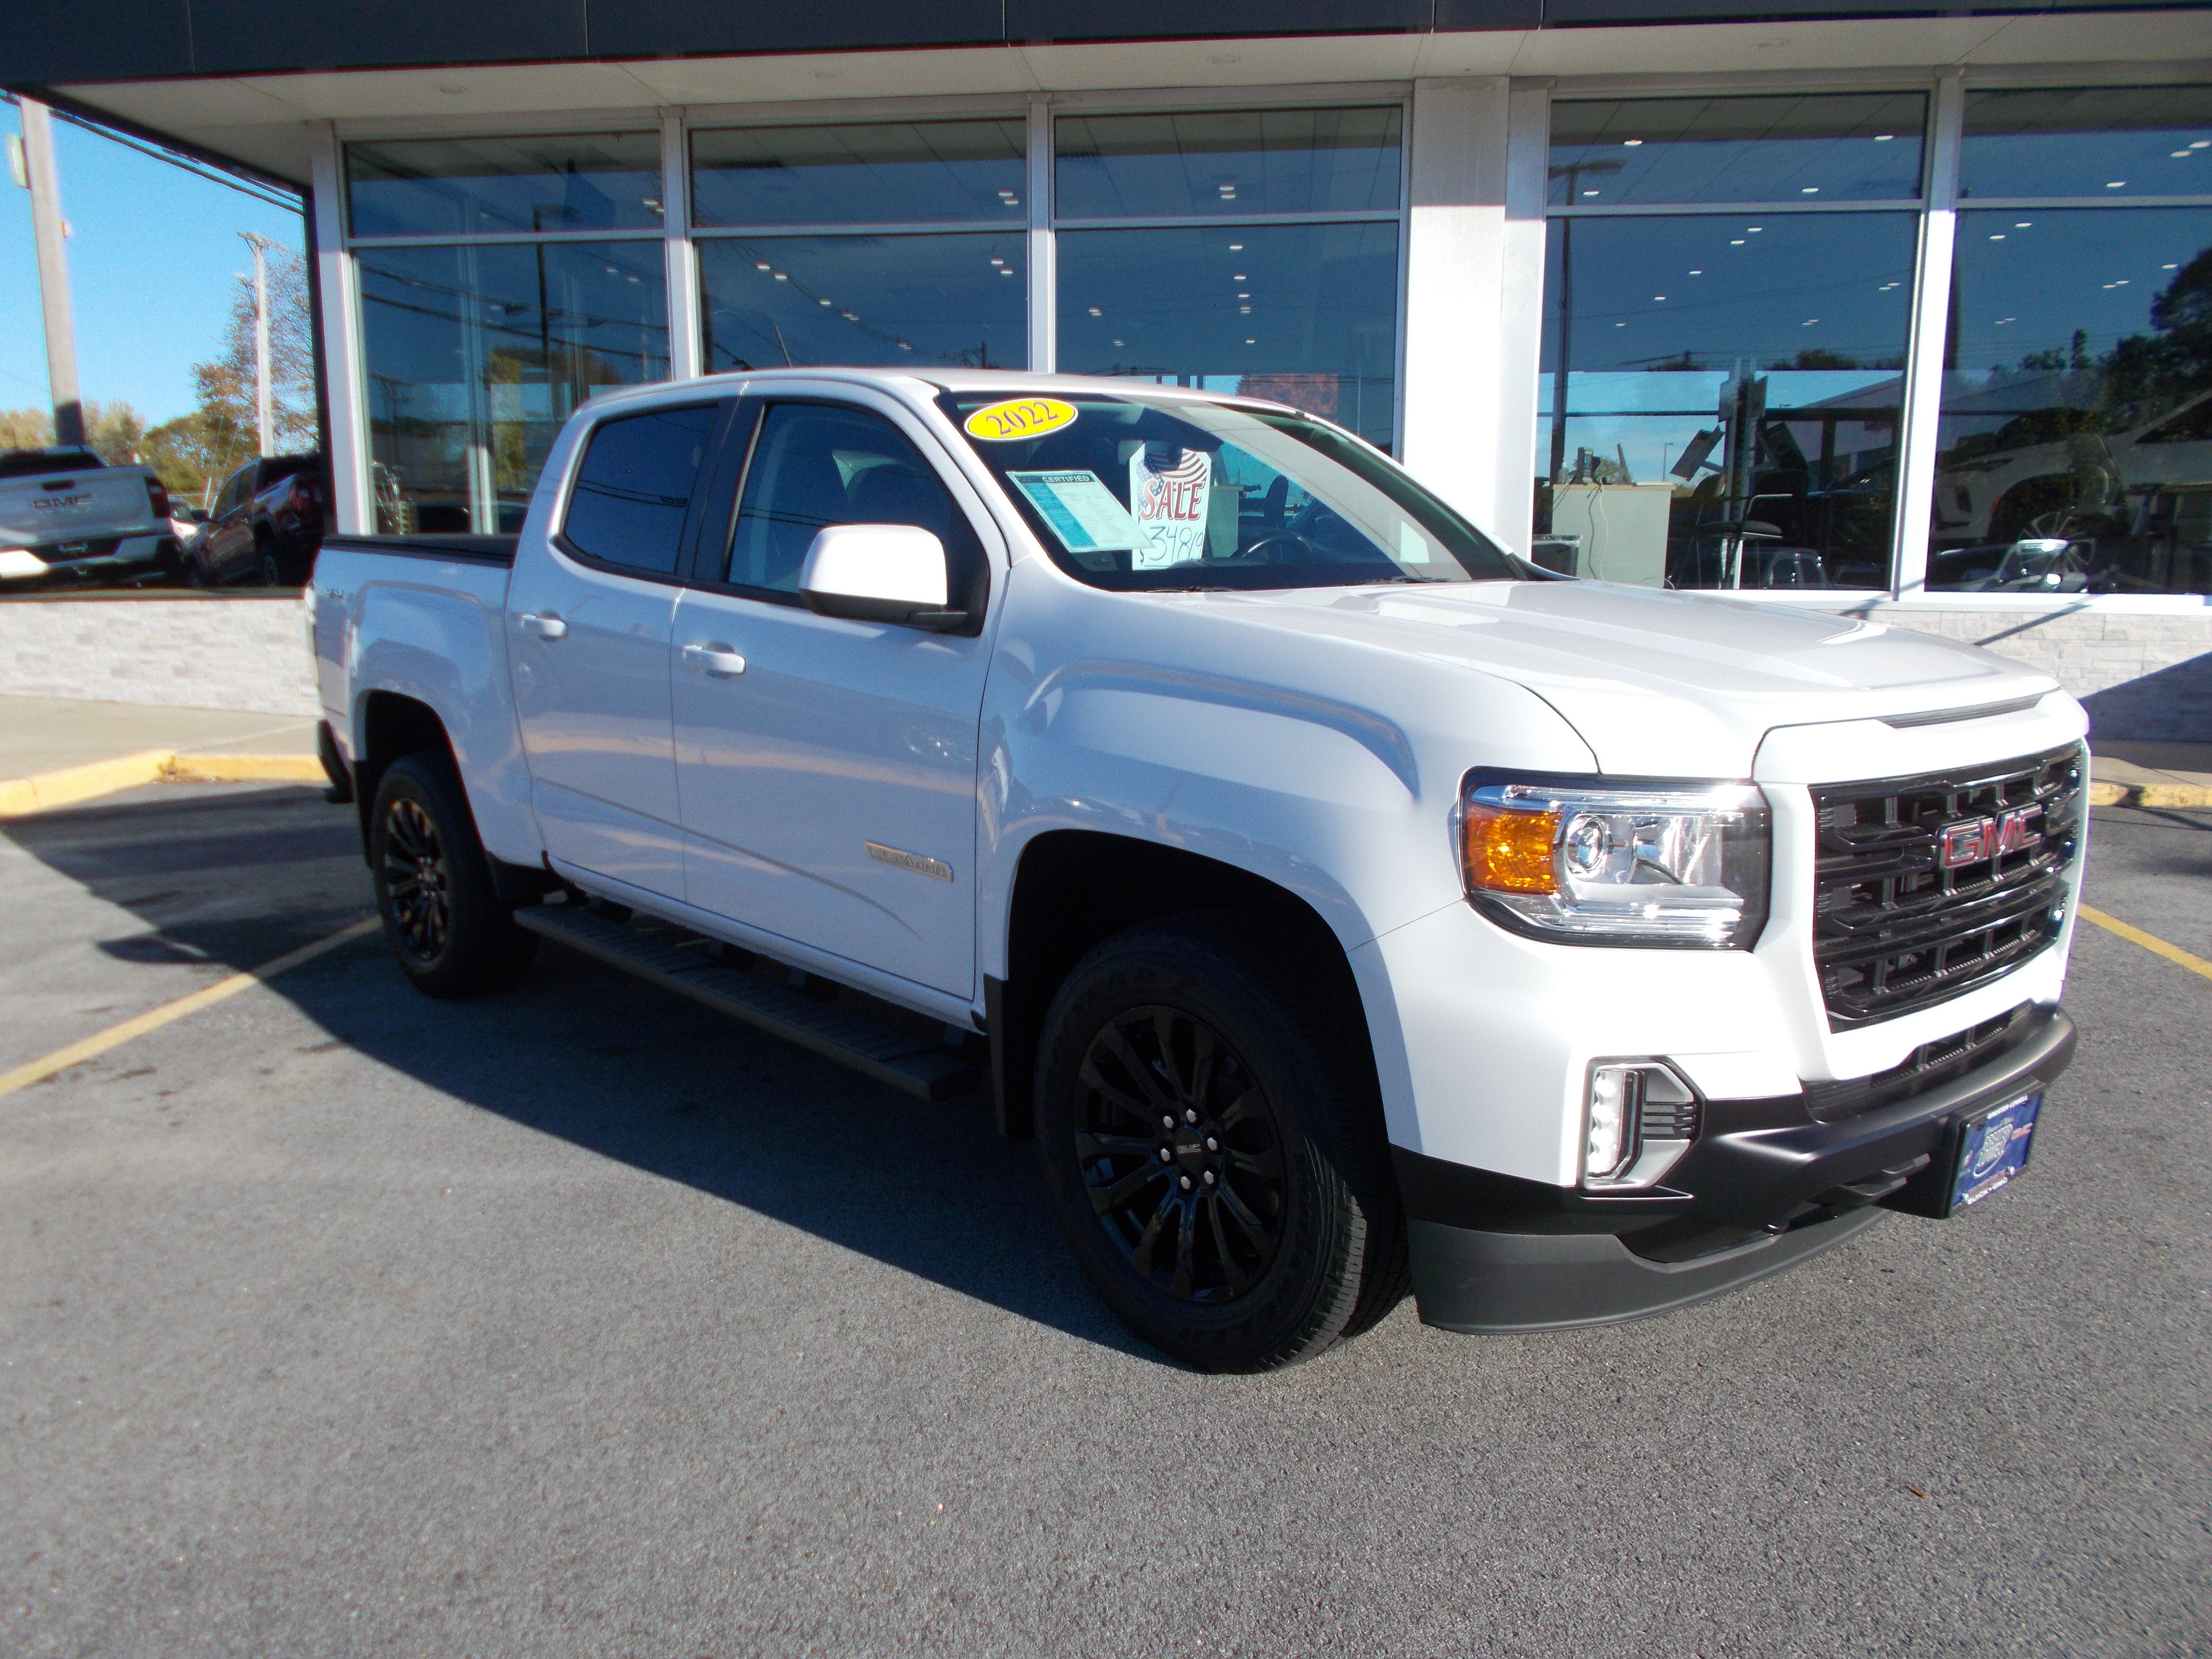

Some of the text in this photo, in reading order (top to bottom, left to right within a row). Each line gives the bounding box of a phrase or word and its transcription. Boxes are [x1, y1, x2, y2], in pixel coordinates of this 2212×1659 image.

[986, 401, 1059, 435] 2022
[33, 493, 92, 509] GMC
[1139, 478, 1208, 521] SALE
[1936, 803, 2043, 867] GMC
[1177, 1143, 1202, 1154] GMC
